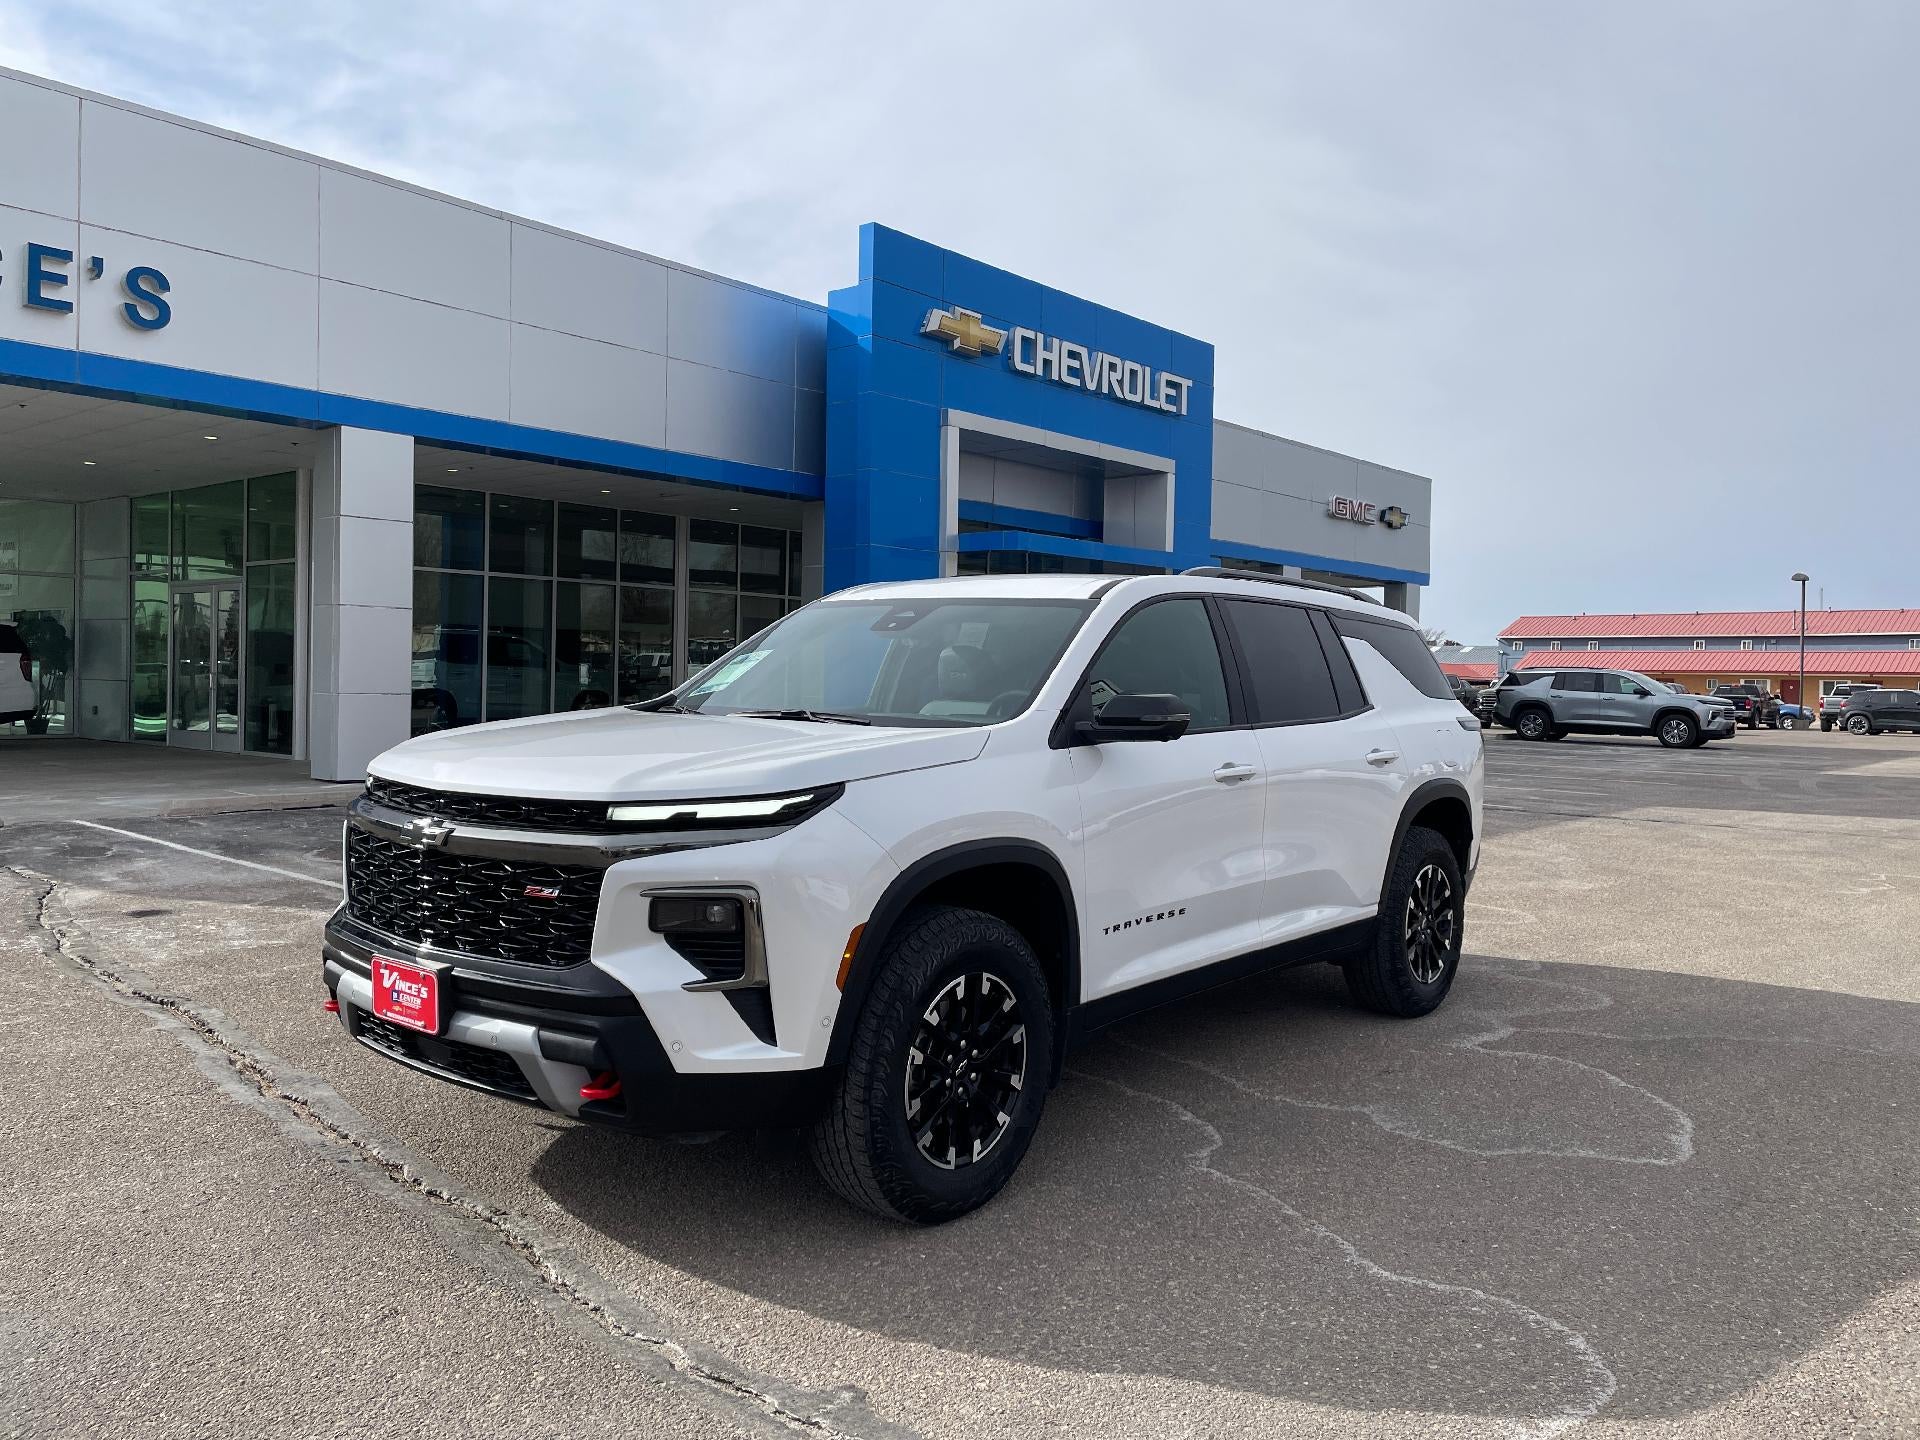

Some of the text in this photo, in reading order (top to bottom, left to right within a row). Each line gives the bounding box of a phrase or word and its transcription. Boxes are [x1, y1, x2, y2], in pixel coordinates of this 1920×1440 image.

[0, 241, 172, 331] E'S
[1008, 326, 1193, 415] CHEVROLET
[1328, 495, 1376, 526] GMC
[1102, 907, 1187, 935] TRAVERSE
